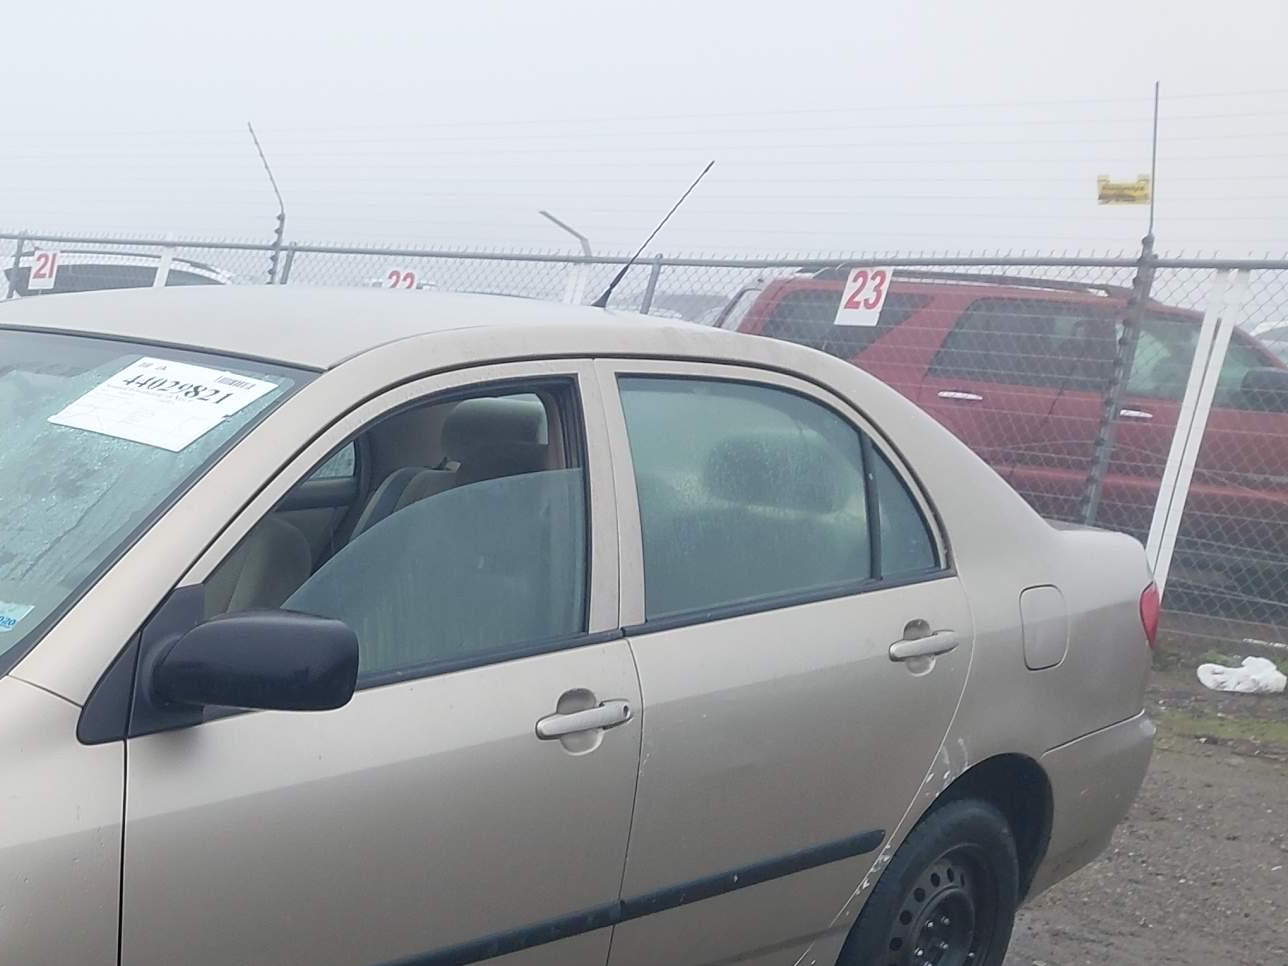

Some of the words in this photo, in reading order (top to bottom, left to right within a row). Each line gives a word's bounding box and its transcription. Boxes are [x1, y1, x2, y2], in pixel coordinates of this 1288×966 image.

[32, 252, 58, 279] 21
[844, 270, 887, 310] 23
[123, 374, 234, 404] 44029821
